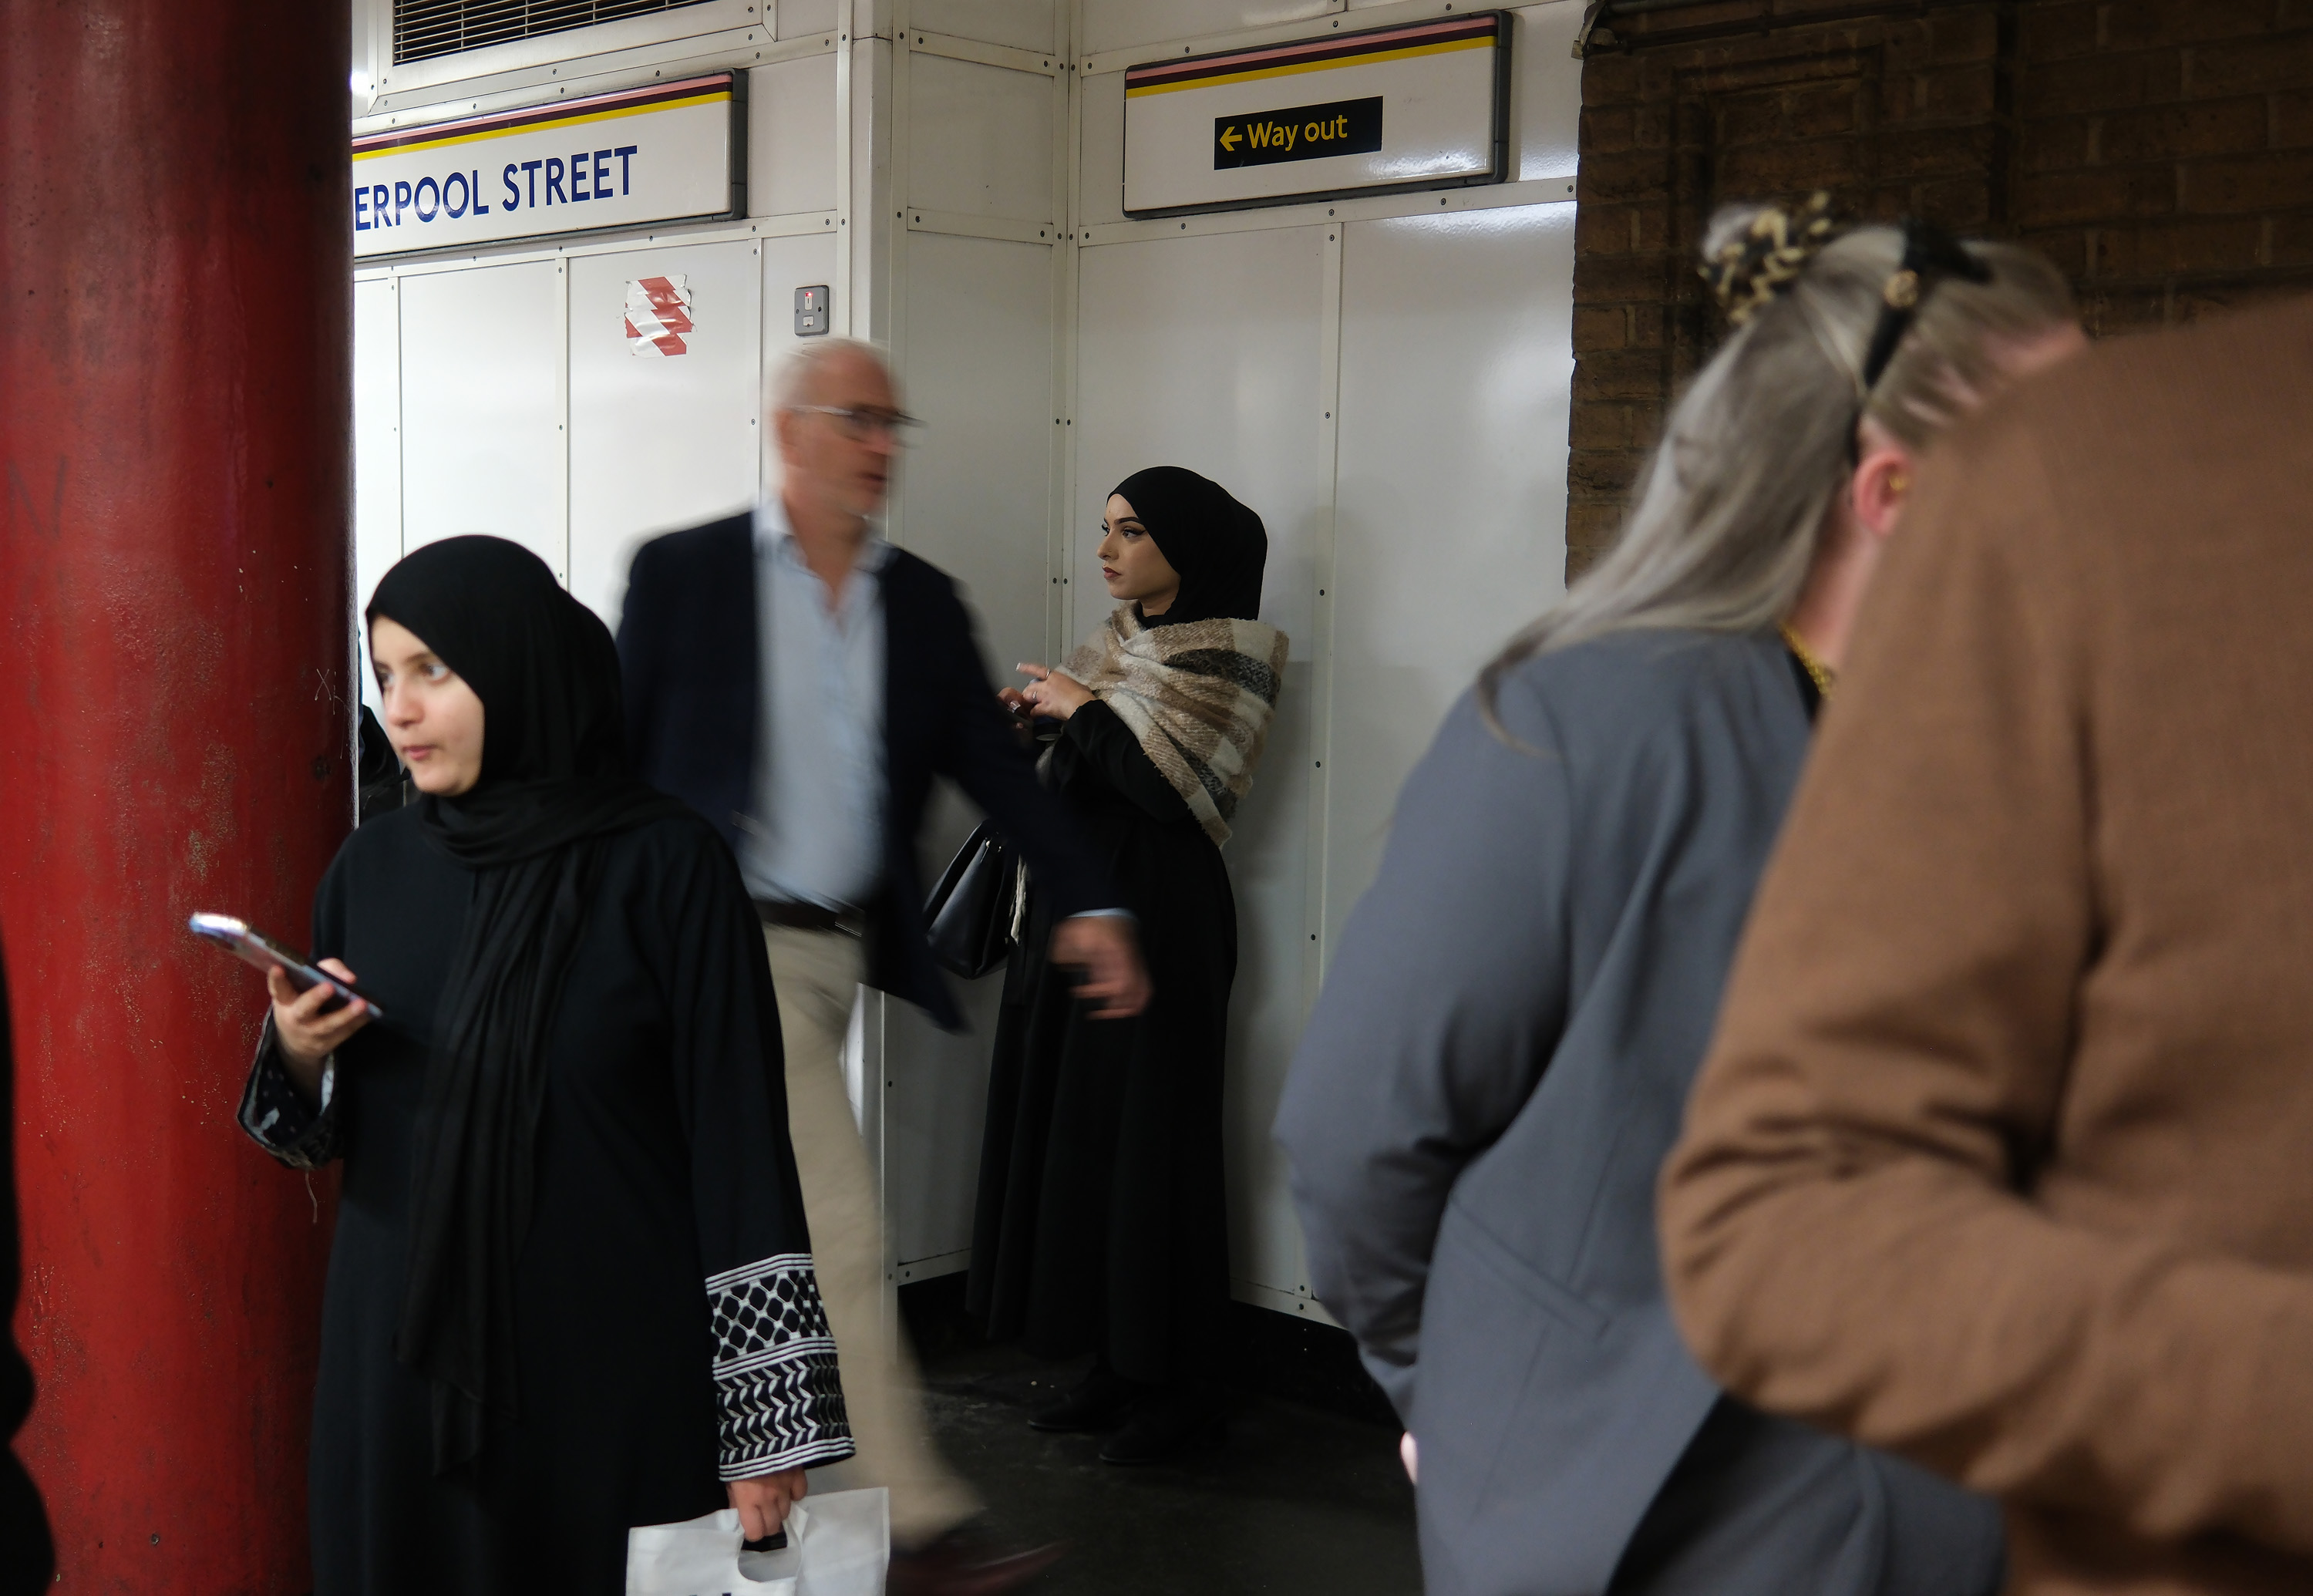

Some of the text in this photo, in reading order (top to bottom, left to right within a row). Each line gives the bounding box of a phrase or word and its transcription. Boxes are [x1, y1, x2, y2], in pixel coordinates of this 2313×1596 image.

[1247, 115, 1348, 151] Way out
[355, 145, 638, 231] ERPOOL STREET
